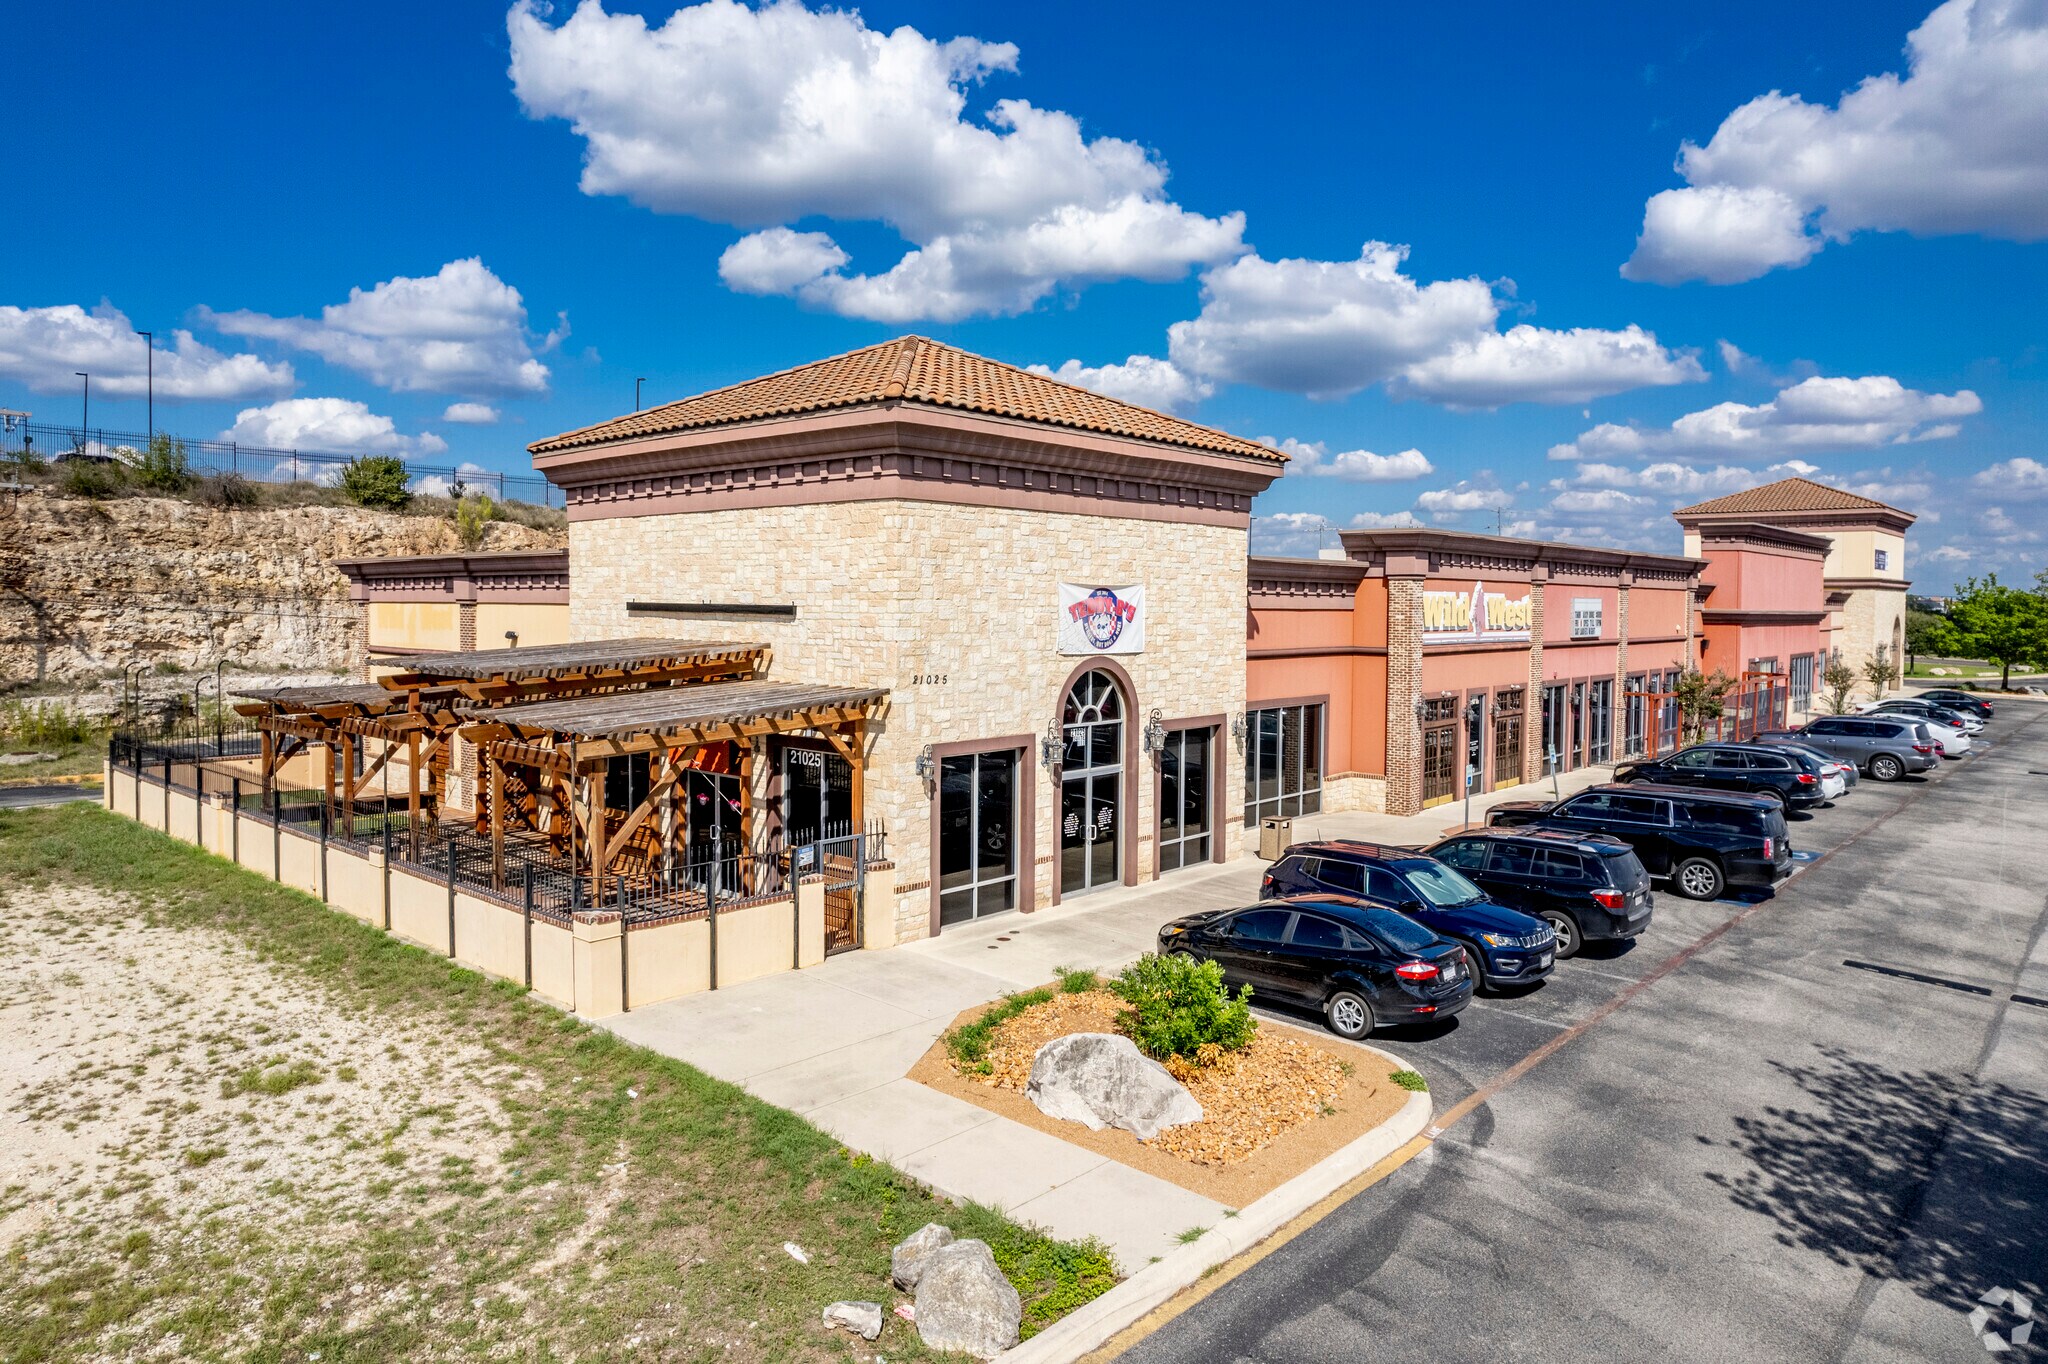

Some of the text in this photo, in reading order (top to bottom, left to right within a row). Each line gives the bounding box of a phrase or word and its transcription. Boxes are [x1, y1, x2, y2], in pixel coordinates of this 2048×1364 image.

[1423, 593, 1469, 631] Wild
[912, 674, 948, 685] 21025
[790, 750, 821, 768] 21025
